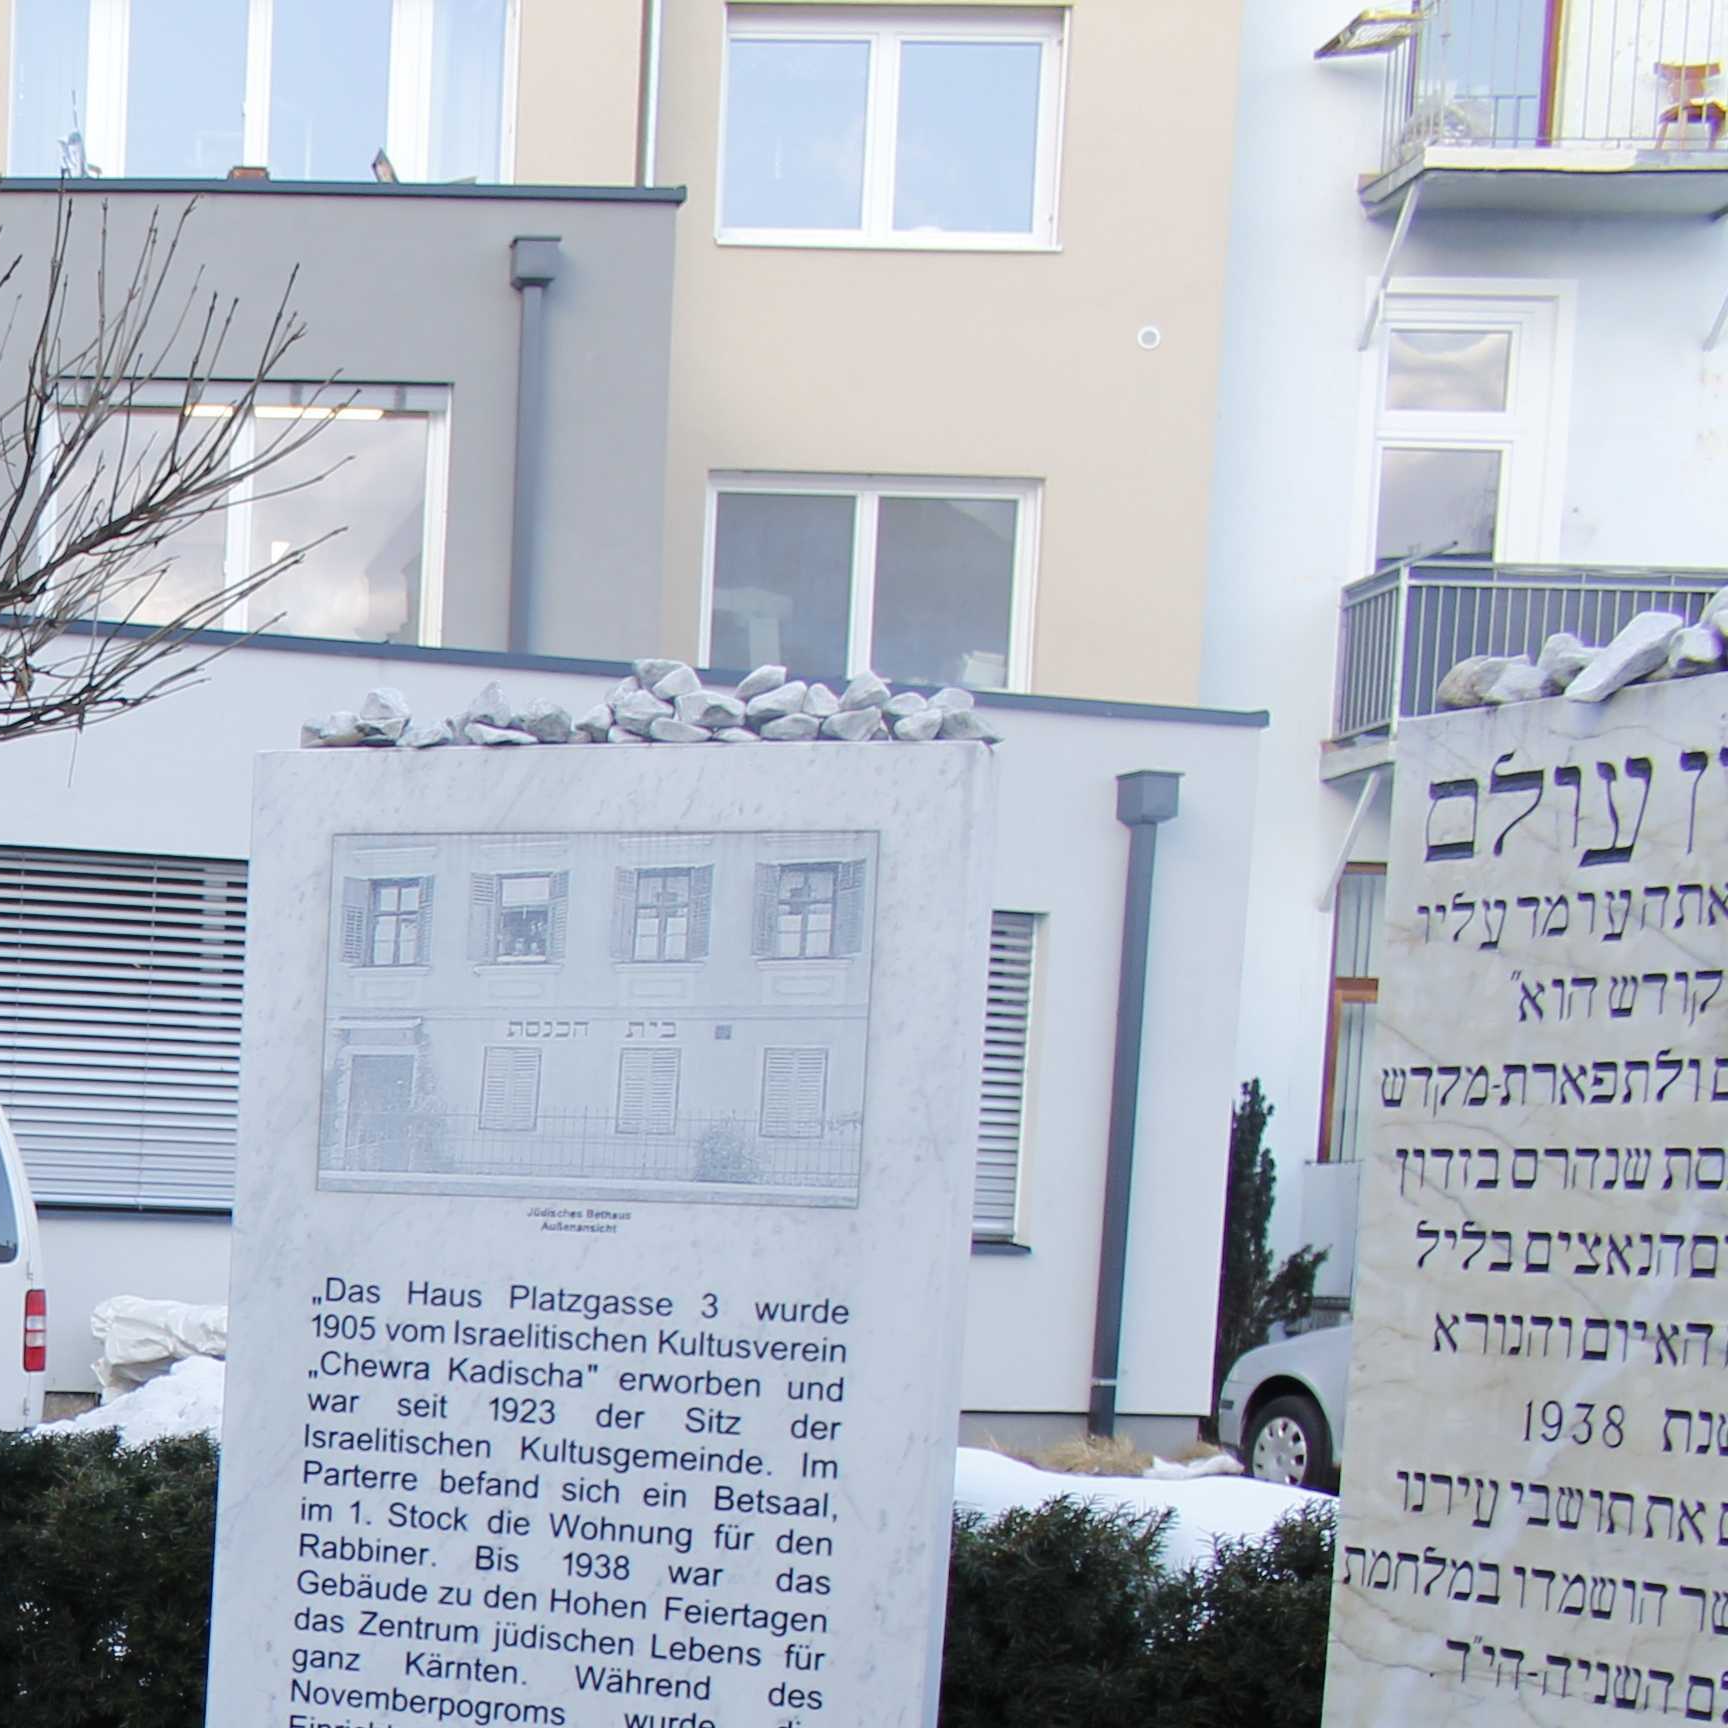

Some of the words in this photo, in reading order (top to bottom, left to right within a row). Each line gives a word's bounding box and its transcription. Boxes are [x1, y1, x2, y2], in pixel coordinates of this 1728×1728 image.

[1424, 750, 1653, 868] עולם
[1417, 891, 1507, 951] עליו
[1608, 970, 1724, 1027] קודש
[1395, 1147, 1500, 1198] בזדון
[1415, 1220, 1513, 1272] בליל
[1523, 1231, 1686, 1278] הנאצים
[407, 1280, 483, 1309] Haus
[509, 1284, 674, 1321] Platzgasse
[700, 1292, 719, 1320] 3
[754, 1297, 851, 1326] wurde
[310, 1313, 377, 1342] 1905
[384, 1322, 446, 1345] vom
[453, 1319, 648, 1355] Israelitischen
[657, 1328, 847, 1364] Kultusverein
[1432, 1311, 1574, 1359] והנורא
[1581, 1317, 1714, 1368] האיום
[618, 1369, 761, 1399] erworben
[787, 1376, 845, 1403] und
[306, 1392, 361, 1414] war
[396, 1392, 449, 1420] seit
[488, 1396, 557, 1426] 1923
[595, 1402, 646, 1430] der
[684, 1406, 742, 1436] Sitz
[789, 1412, 843, 1441] der
[1524, 1399, 1627, 1449] 1938
[303, 1422, 492, 1459] Israelitischen
[519, 1435, 773, 1477] Kultusgemeinde.
[801, 1451, 839, 1481] Im
[302, 1459, 419, 1492] Parterre
[439, 1467, 540, 1500] befand
[561, 1476, 621, 1505] sich
[642, 1481, 687, 1509] ein
[713, 1484, 838, 1523] Betsaal,
[300, 1496, 333, 1523] im
[349, 1499, 372, 1526] 1.
[387, 1501, 469, 1532] Stock
[486, 1508, 531, 1537] die
[548, 1512, 693, 1555] Wohnung
[713, 1522, 756, 1552] für
[775, 1527, 833, 1557] den
[298, 1532, 437, 1568] Rabbiner.
[474, 1544, 520, 1574] Bis
[562, 1551, 631, 1582] 1938
[667, 1564, 725, 1588] war
[775, 1566, 832, 1596] das
[1343, 1546, 1500, 1605] במלחמת
[296, 1568, 429, 1604] Gebäude
[437, 1585, 473, 1607] zu
[482, 1583, 538, 1612] den
[549, 1587, 647, 1621] Hohen
[663, 1595, 828, 1638] Feiertagen
[1513, 1565, 1668, 1628] הושמדו
[293, 1606, 345, 1635] das
[357, 1609, 480, 1645] Zentrum
[490, 1620, 635, 1657] jüdischen
[650, 1632, 763, 1668] Lebens
[783, 1642, 827, 1672] für
[290, 1677, 566, 1727] Novemberpogroms
[291, 1647, 362, 1675] ganz
[404, 1650, 527, 1686] Kärnten.
[574, 1664, 712, 1702] Während
[767, 1681, 823, 1711] des
